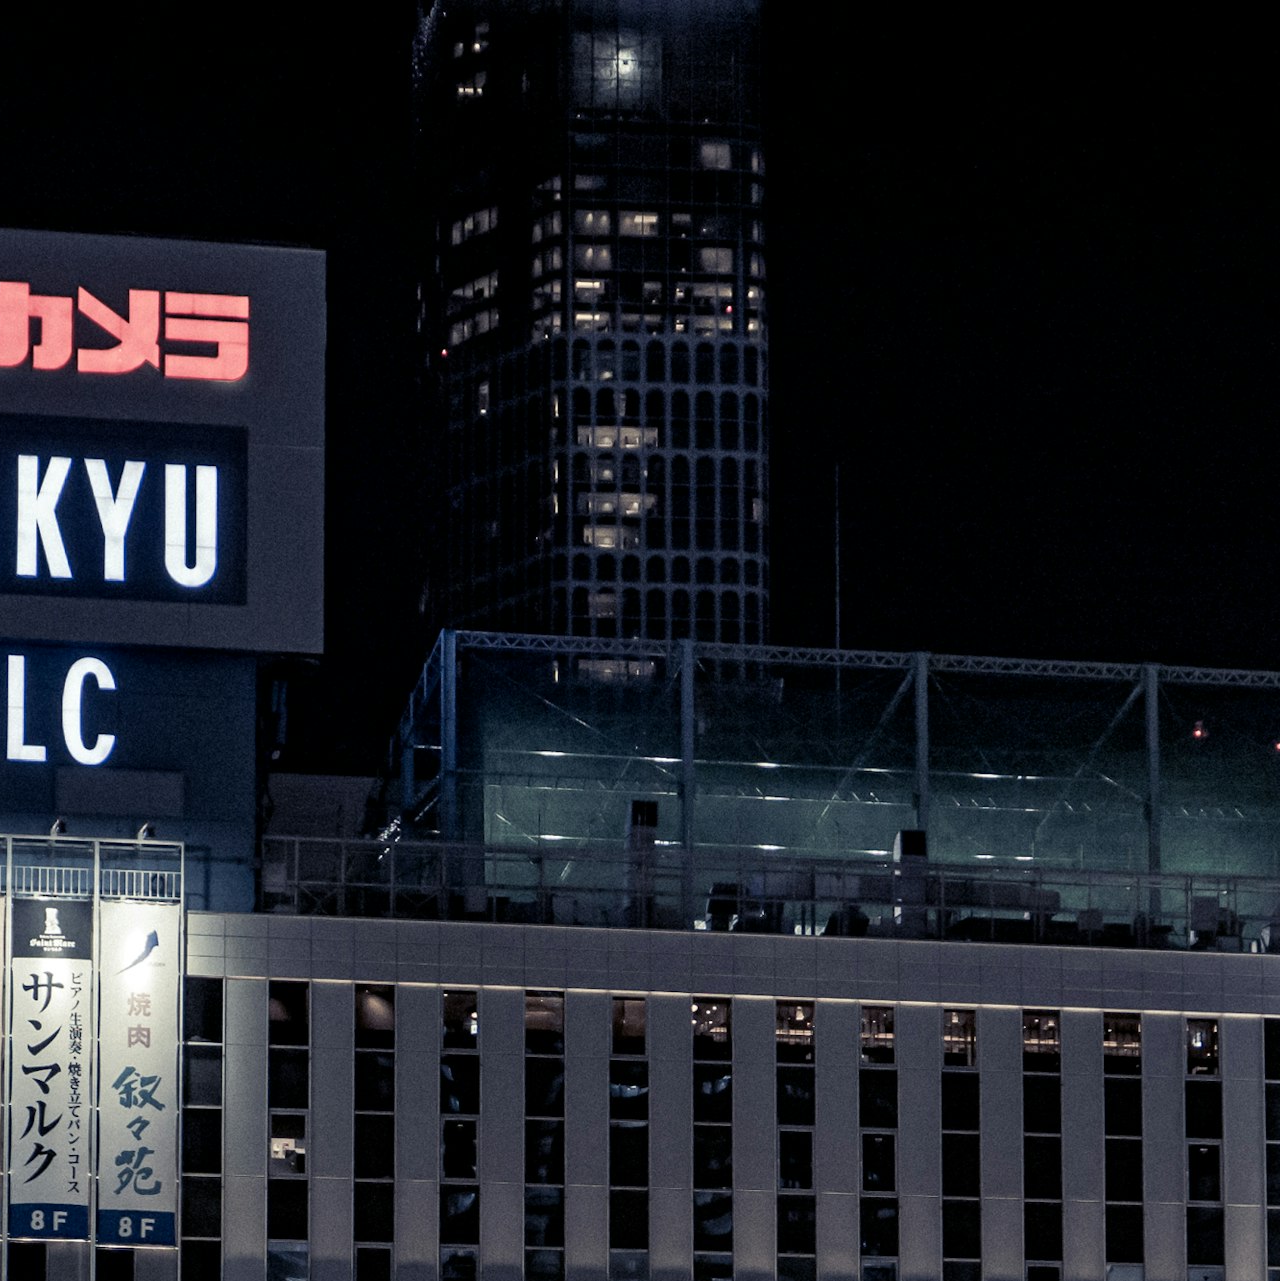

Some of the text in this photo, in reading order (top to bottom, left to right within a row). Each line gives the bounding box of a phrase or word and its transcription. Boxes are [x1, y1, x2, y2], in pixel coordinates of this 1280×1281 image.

[20, 971, 64, 1185] サンマルク
[127, 992, 151, 1049] 焼肉
